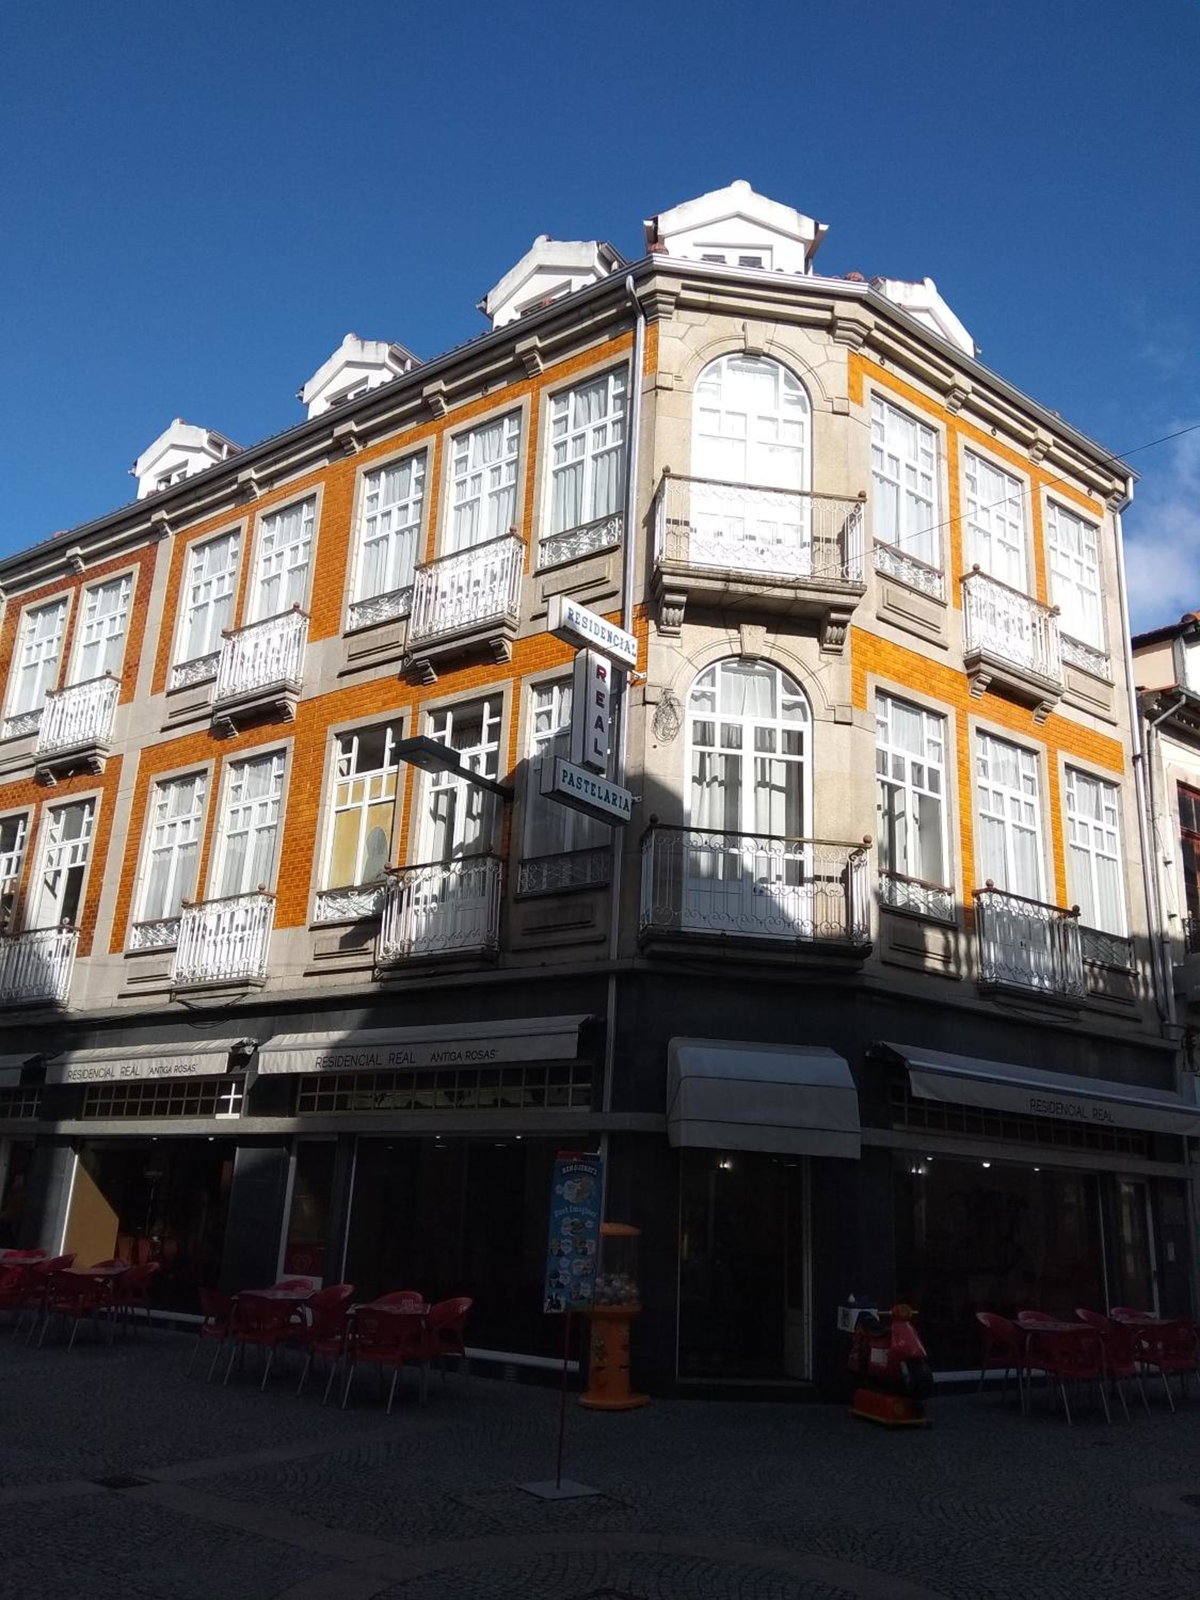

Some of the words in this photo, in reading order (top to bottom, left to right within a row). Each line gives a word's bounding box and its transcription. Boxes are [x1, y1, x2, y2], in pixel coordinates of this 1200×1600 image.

[567, 607, 637, 658] RESIDENCIAL
[594, 664, 607, 756] REAL
[561, 769, 631, 813] PASTELARIA
[67, 1066, 115, 1081] RESIDENCIAL
[120, 1065, 140, 1077] REAL
[315, 1054, 382, 1069] RESIDENCIAL
[388, 1051, 416, 1065] REAL
[1029, 1097, 1087, 1119] RESIDENCIAL
[1092, 1107, 1115, 1124] REAL
